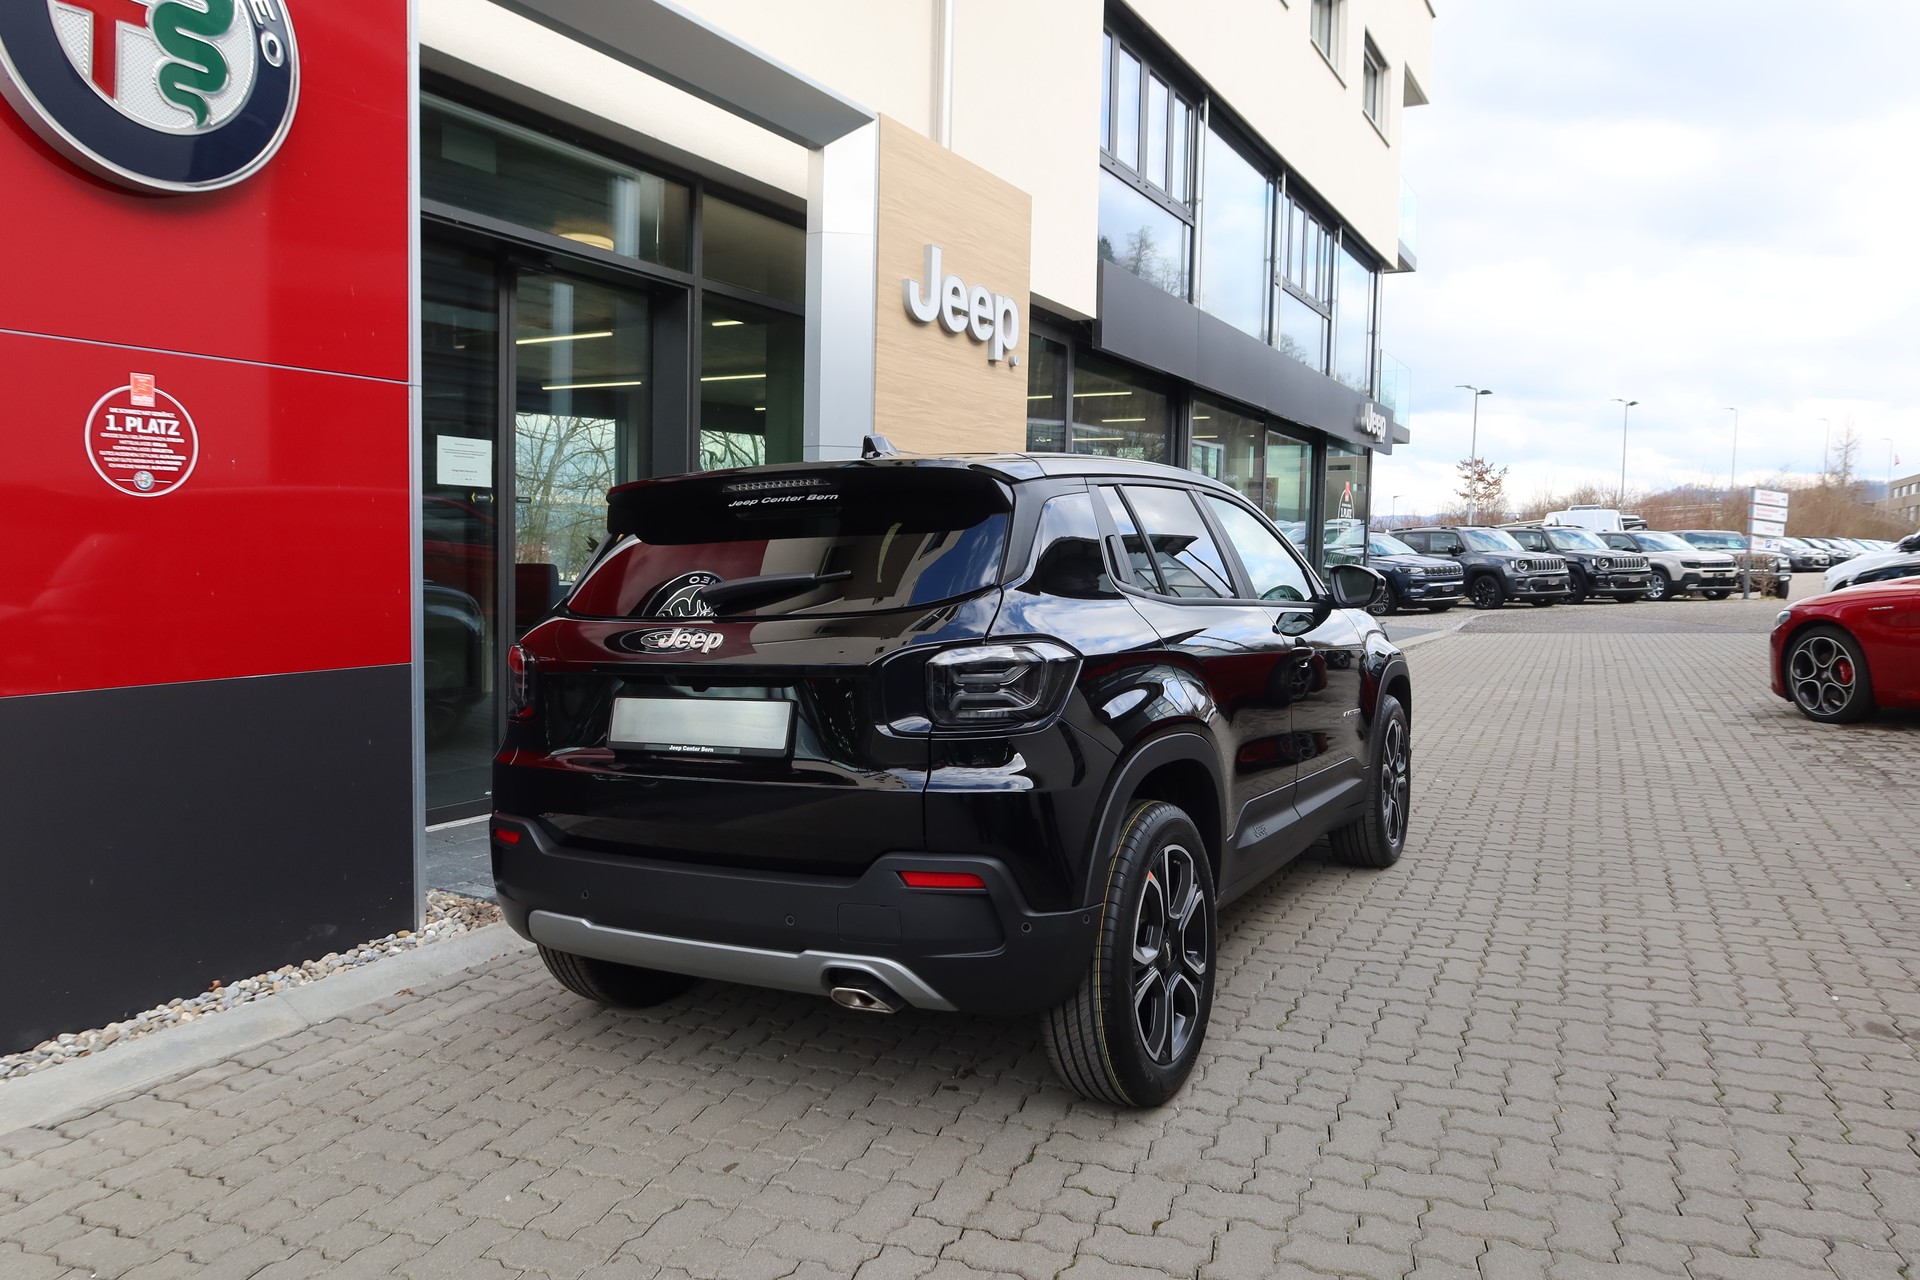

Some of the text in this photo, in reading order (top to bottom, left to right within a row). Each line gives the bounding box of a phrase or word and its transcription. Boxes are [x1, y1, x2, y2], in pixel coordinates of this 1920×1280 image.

[902, 244, 1020, 364] Jeep
[105, 415, 181, 436] 1. PLATZ
[1360, 402, 1387, 443] Jeep
[728, 499, 759, 507] Jeep
[761, 495, 805, 504] Center
[657, 627, 724, 654] Jeep
[669, 744, 682, 752] Jeep
